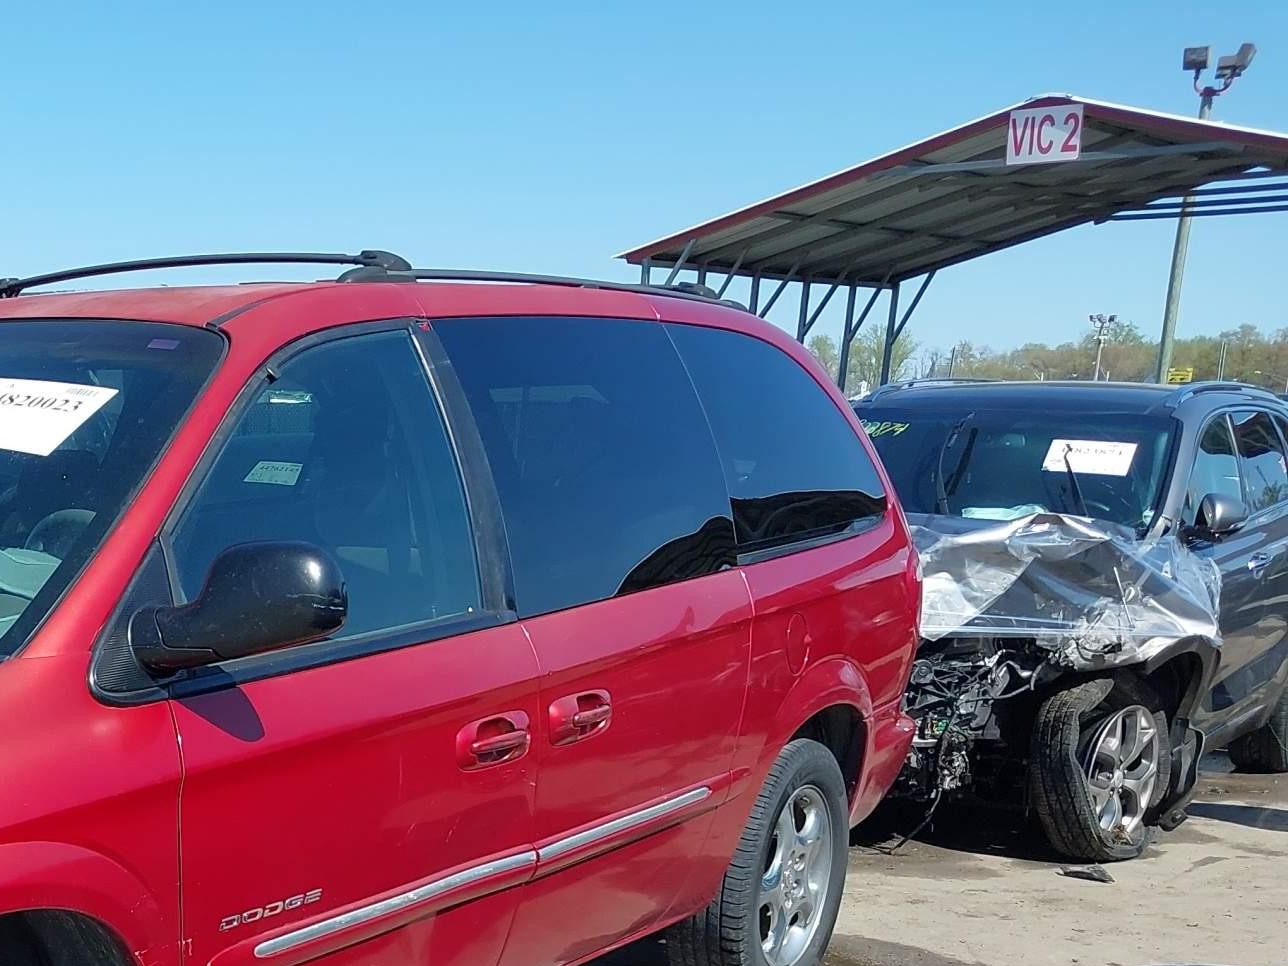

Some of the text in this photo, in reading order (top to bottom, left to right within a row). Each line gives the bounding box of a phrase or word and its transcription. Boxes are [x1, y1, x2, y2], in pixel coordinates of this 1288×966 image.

[1011, 111, 1080, 157] VIC 2
[218, 888, 323, 931] DODGE
